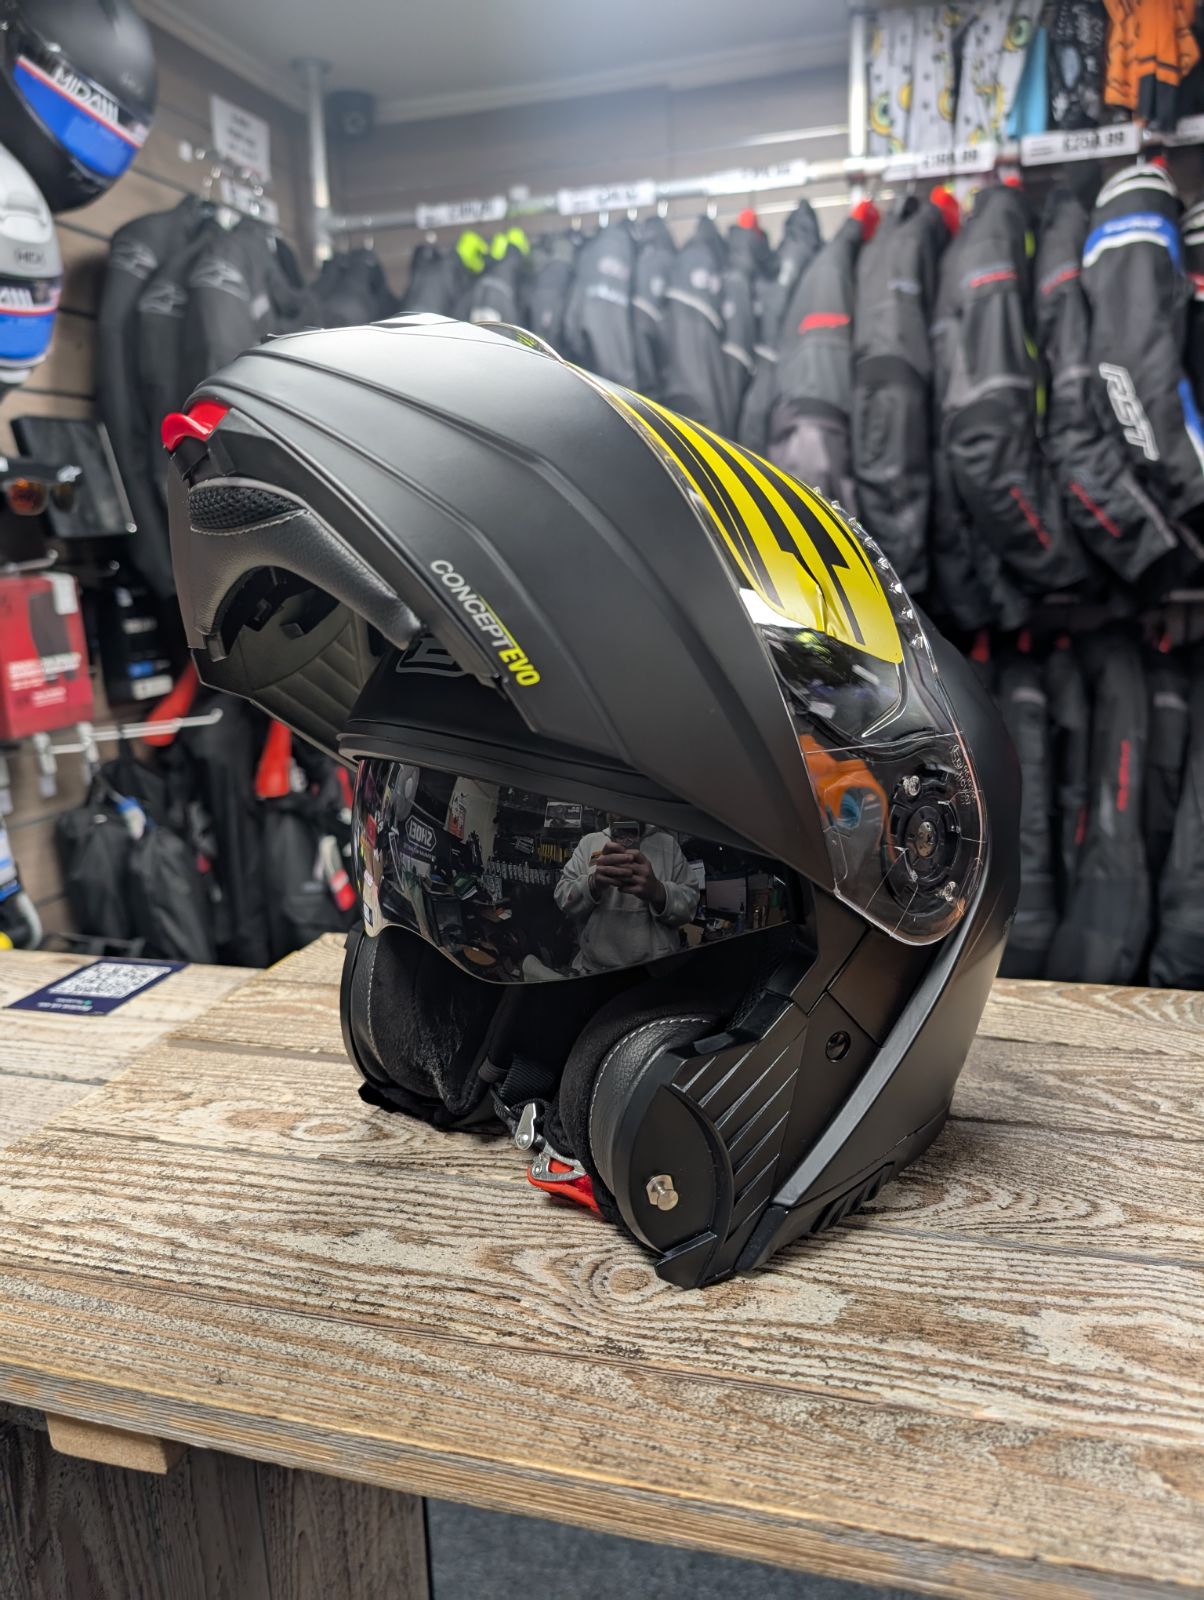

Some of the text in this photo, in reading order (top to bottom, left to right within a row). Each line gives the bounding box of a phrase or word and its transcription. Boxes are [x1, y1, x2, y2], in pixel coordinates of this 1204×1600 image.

[1098, 361, 1160, 462] RST
[429, 559, 541, 686] CONCEPT EVO
